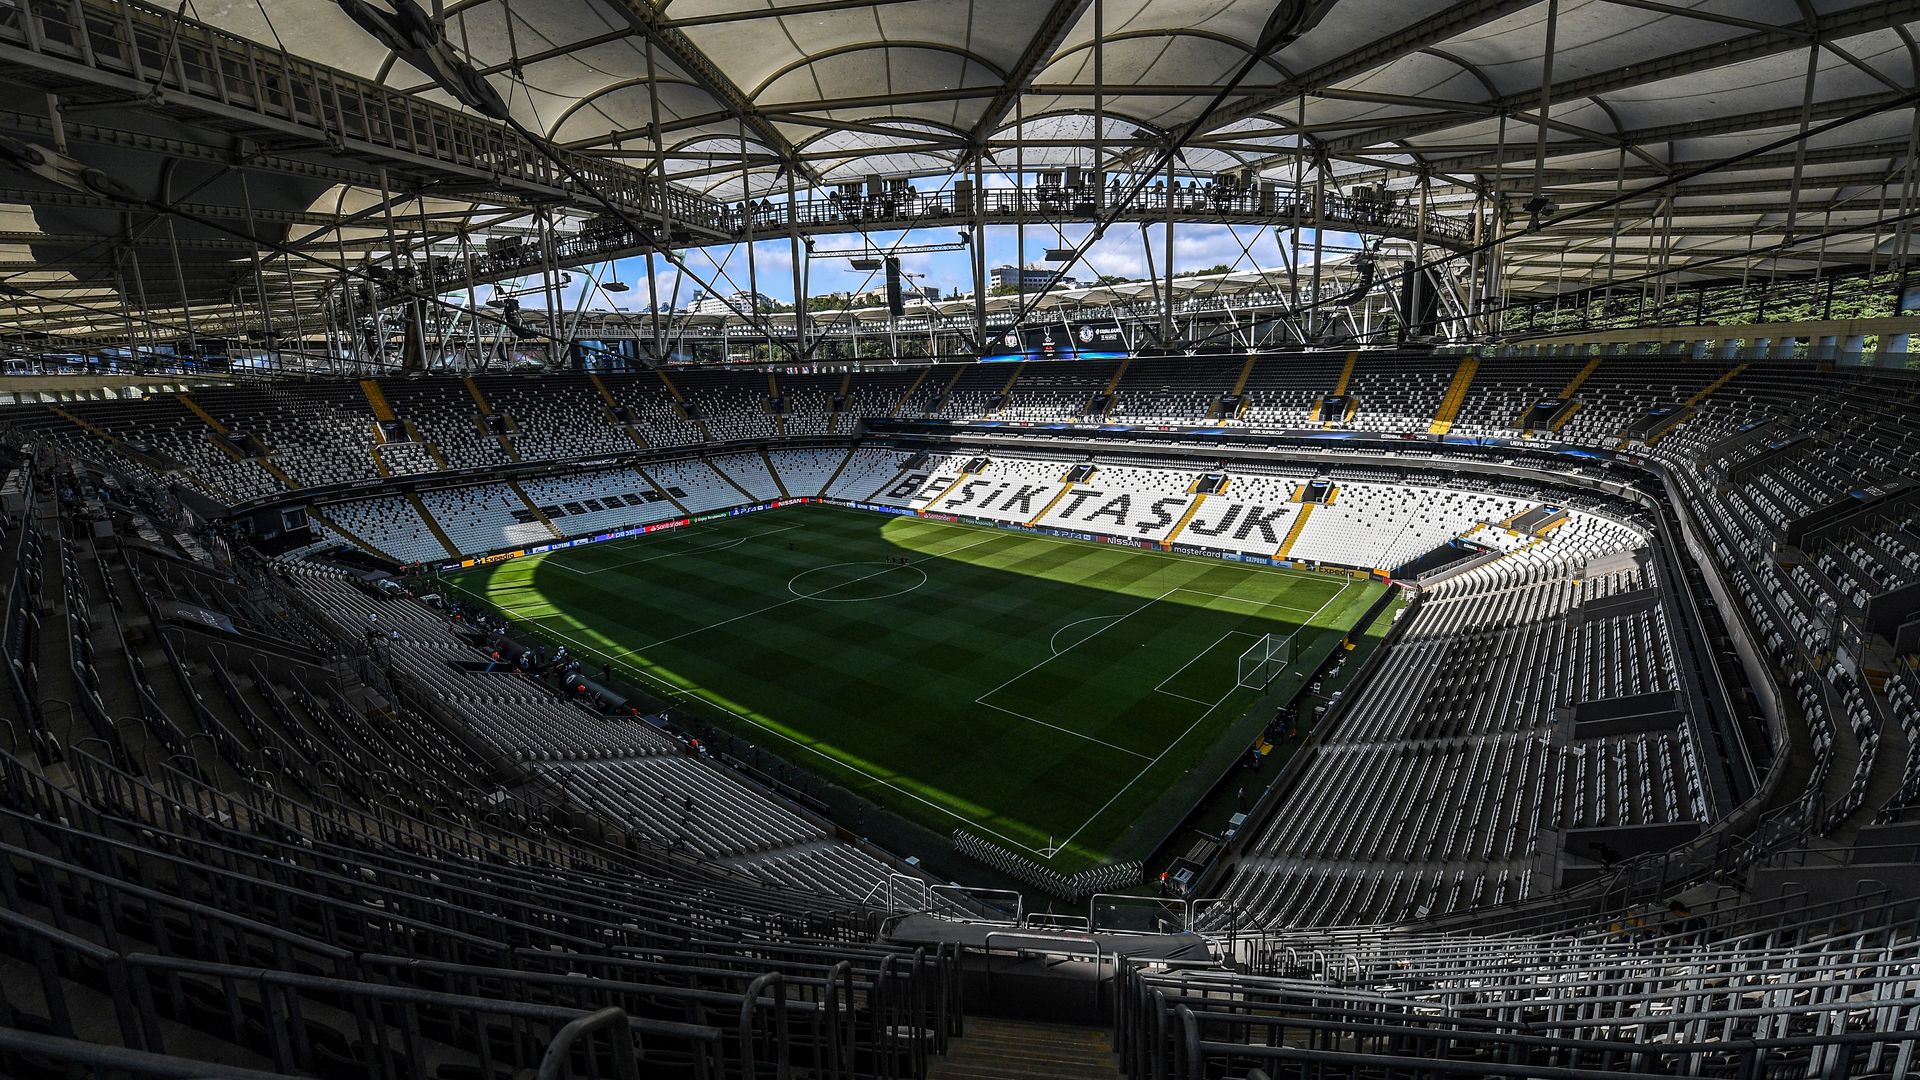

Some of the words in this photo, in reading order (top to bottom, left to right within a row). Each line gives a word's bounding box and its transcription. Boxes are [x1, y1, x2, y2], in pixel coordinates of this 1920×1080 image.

[778, 498, 802, 507] NISSAN
[928, 513, 951, 521] Santander
[656, 520, 684, 531] Santander
[1188, 503, 1291, 544] JK
[1061, 531, 1082, 540] PS4
[1107, 537, 1142, 548] NISSAN
[1173, 546, 1221, 559] mastercard
[1318, 565, 1355, 578] Expedia
